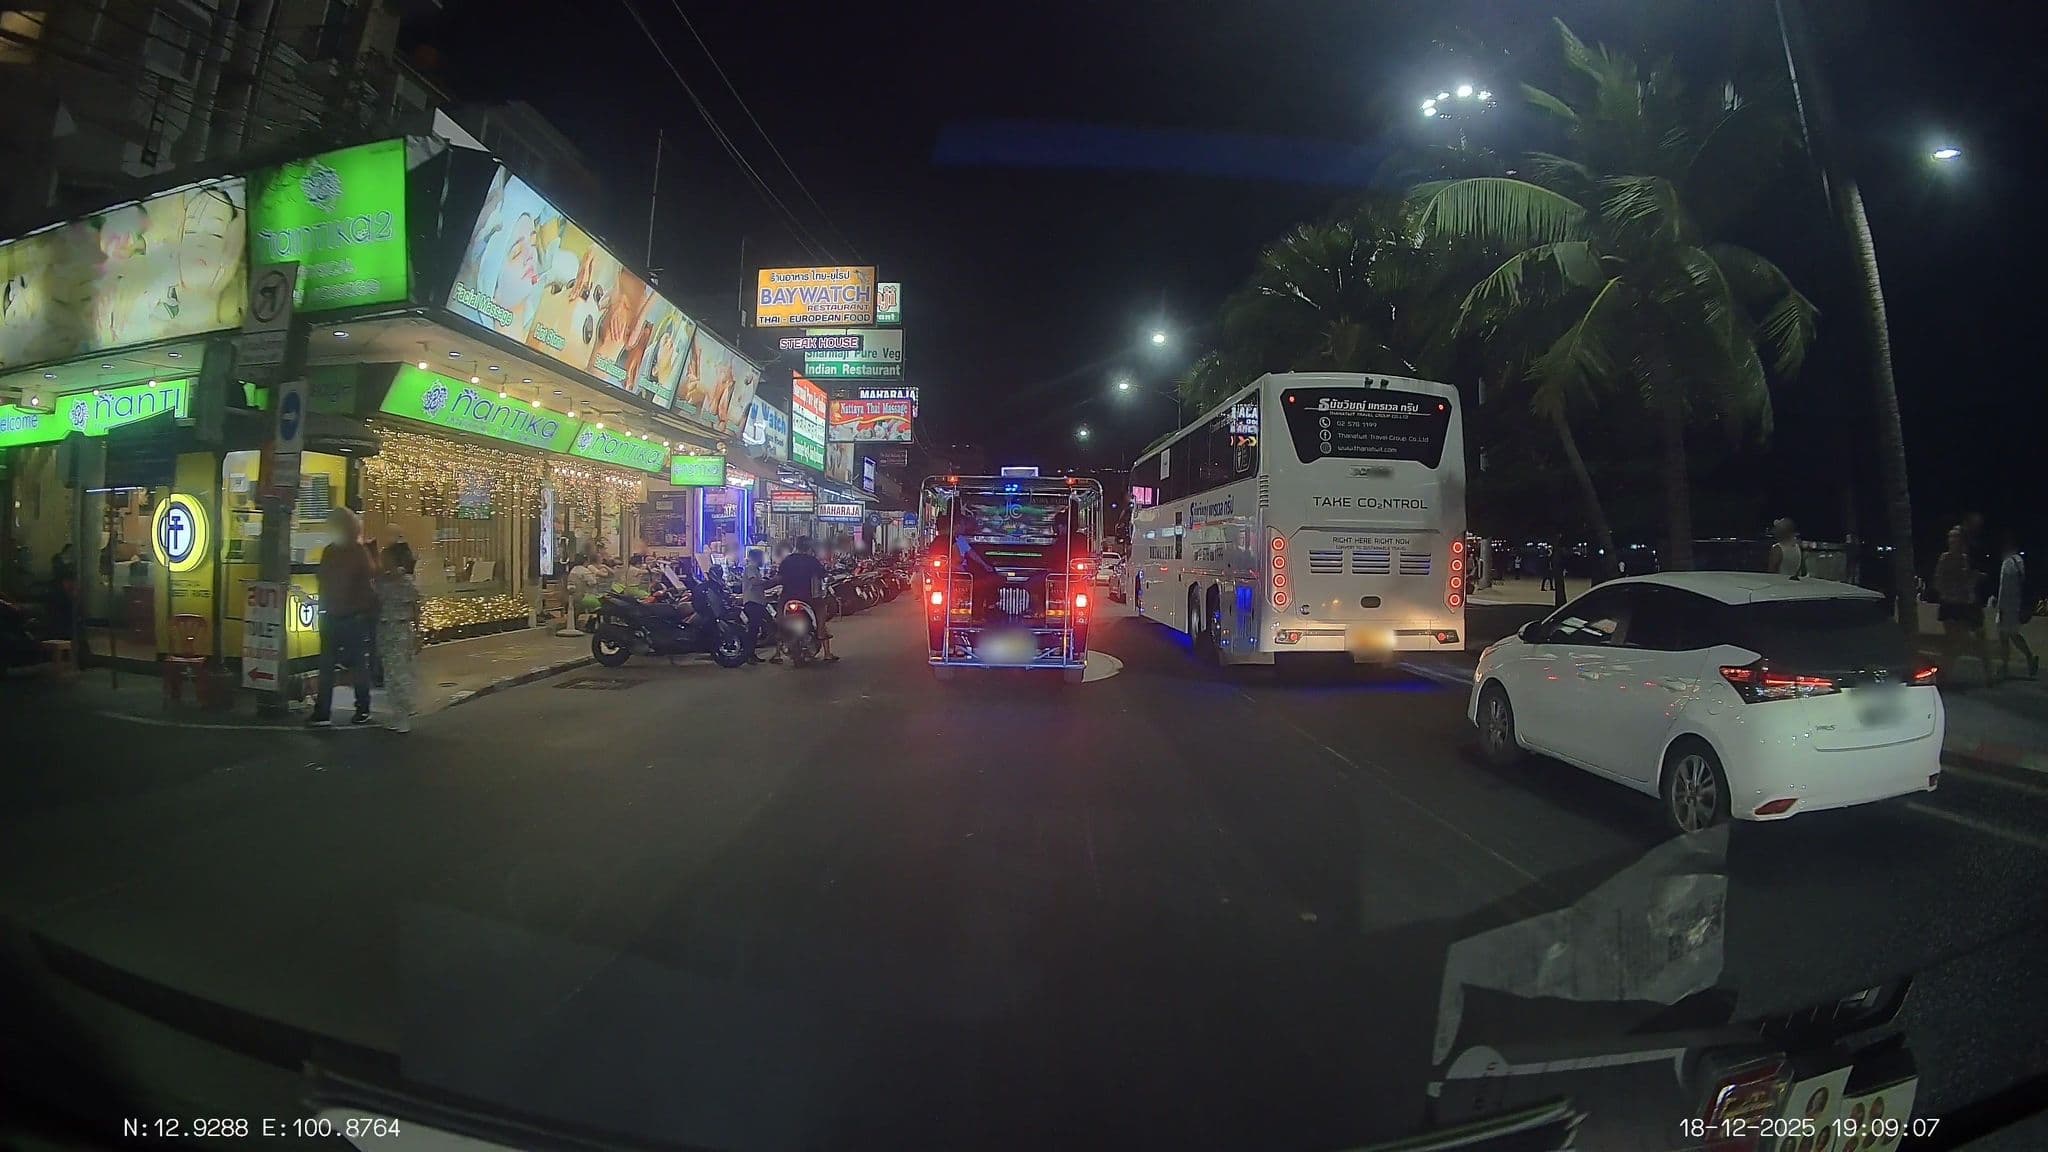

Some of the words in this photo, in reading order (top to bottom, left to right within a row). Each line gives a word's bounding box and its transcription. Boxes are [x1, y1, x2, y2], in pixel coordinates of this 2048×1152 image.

[760, 284, 871, 305] BAYWATCH
[452, 281, 479, 309] Facial
[478, 292, 513, 327] Massage
[807, 304, 869, 312] RESTAURANT
[789, 314, 841, 323] EUROPEAN
[844, 313, 871, 321] FOOD
[780, 337, 817, 349] STEAK
[819, 337, 859, 348] HOUSE
[854, 350, 878, 358] Pure
[882, 348, 901, 360] Veg
[805, 363, 837, 375] Indian
[842, 363, 901, 375] Restaurant
[860, 390, 916, 400] MAHARAJA
[866, 402, 880, 414] Thai
[882, 402, 908, 416] Massage
[0, 414, 38, 432] elcome
[1312, 496, 1352, 508] TAKE
[820, 506, 860, 516] MAHARAJA
[1332, 536, 1352, 544] RIGHT
[1354, 537, 1372, 545] HERE
[1374, 537, 1393, 545] RIGHT
